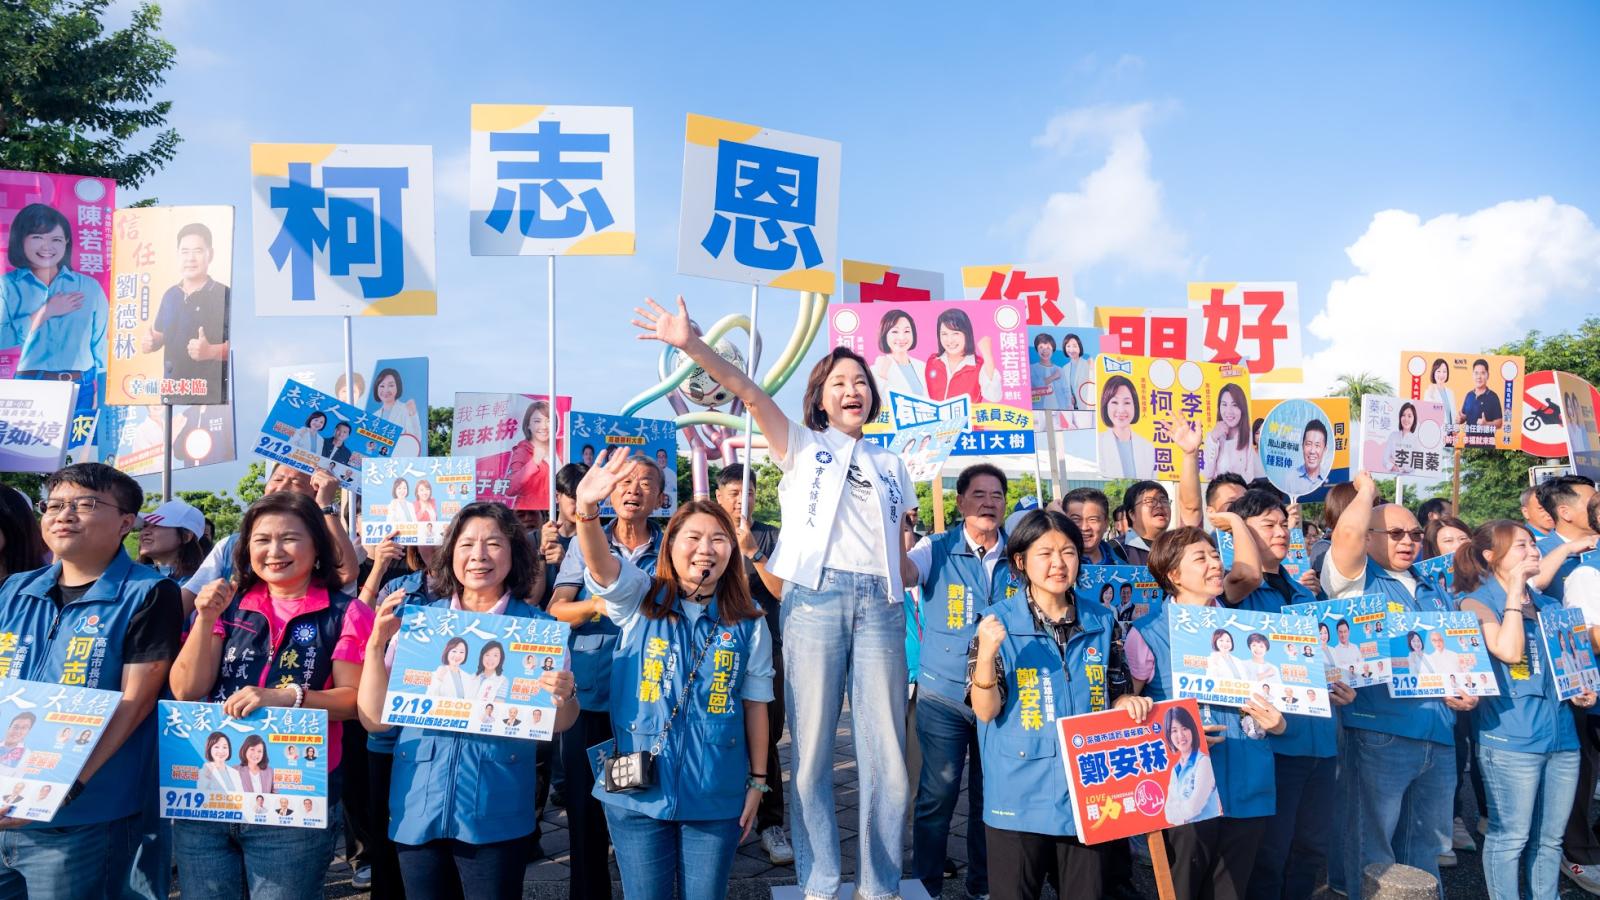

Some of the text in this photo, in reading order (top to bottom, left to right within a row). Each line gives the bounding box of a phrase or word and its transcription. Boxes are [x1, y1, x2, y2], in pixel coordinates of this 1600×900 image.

[485, 121, 615, 238] 志
[701, 139, 825, 270] 恩
[77, 205, 104, 275] 陳若翠
[268, 162, 408, 300] 柯
[115, 273, 138, 360] 劉德林
[1203, 288, 1289, 374] 好
[999, 332, 1021, 388] 陳若翠
[130, 379, 208, 395] 幸福就來臨
[281, 384, 350, 422] 志家人
[456, 400, 510, 423] 我年輕
[571, 413, 628, 439] 志家人
[975, 409, 1030, 428] 議員支持
[260, 436, 292, 455] 9/19
[1149, 389, 1176, 473] 柯志恩
[364, 459, 427, 485] 志家人
[1394, 448, 1441, 472] 李眉蓁
[806, 466, 826, 529] 市長候選人
[366, 524, 393, 536] 9/19
[1080, 567, 1129, 589] 志家人
[946, 584, 966, 630] 劉德林
[1174, 607, 1256, 634] 志家人
[1259, 613, 1314, 635] 大集結
[1289, 604, 1345, 622] 家人
[402, 612, 563, 645] 志家人 大集結
[60, 637, 95, 685] 柯志
[236, 648, 256, 680] 仁武
[706, 650, 735, 714] 柯志恩
[1179, 676, 1215, 692] 9/19
[1392, 676, 1418, 690] 9/19
[42, 686, 112, 715] 大集結
[391, 695, 433, 715] 9/19
[437, 700, 472, 710] 15:00
[1015, 667, 1043, 731] 鄭安秝
[163, 705, 320, 739] 志家人 大集結
[1077, 740, 1170, 787] 鄭安秝
[165, 790, 206, 809] 9/19
[209, 793, 244, 803] 15:00
[1086, 793, 1106, 804] LOVE
